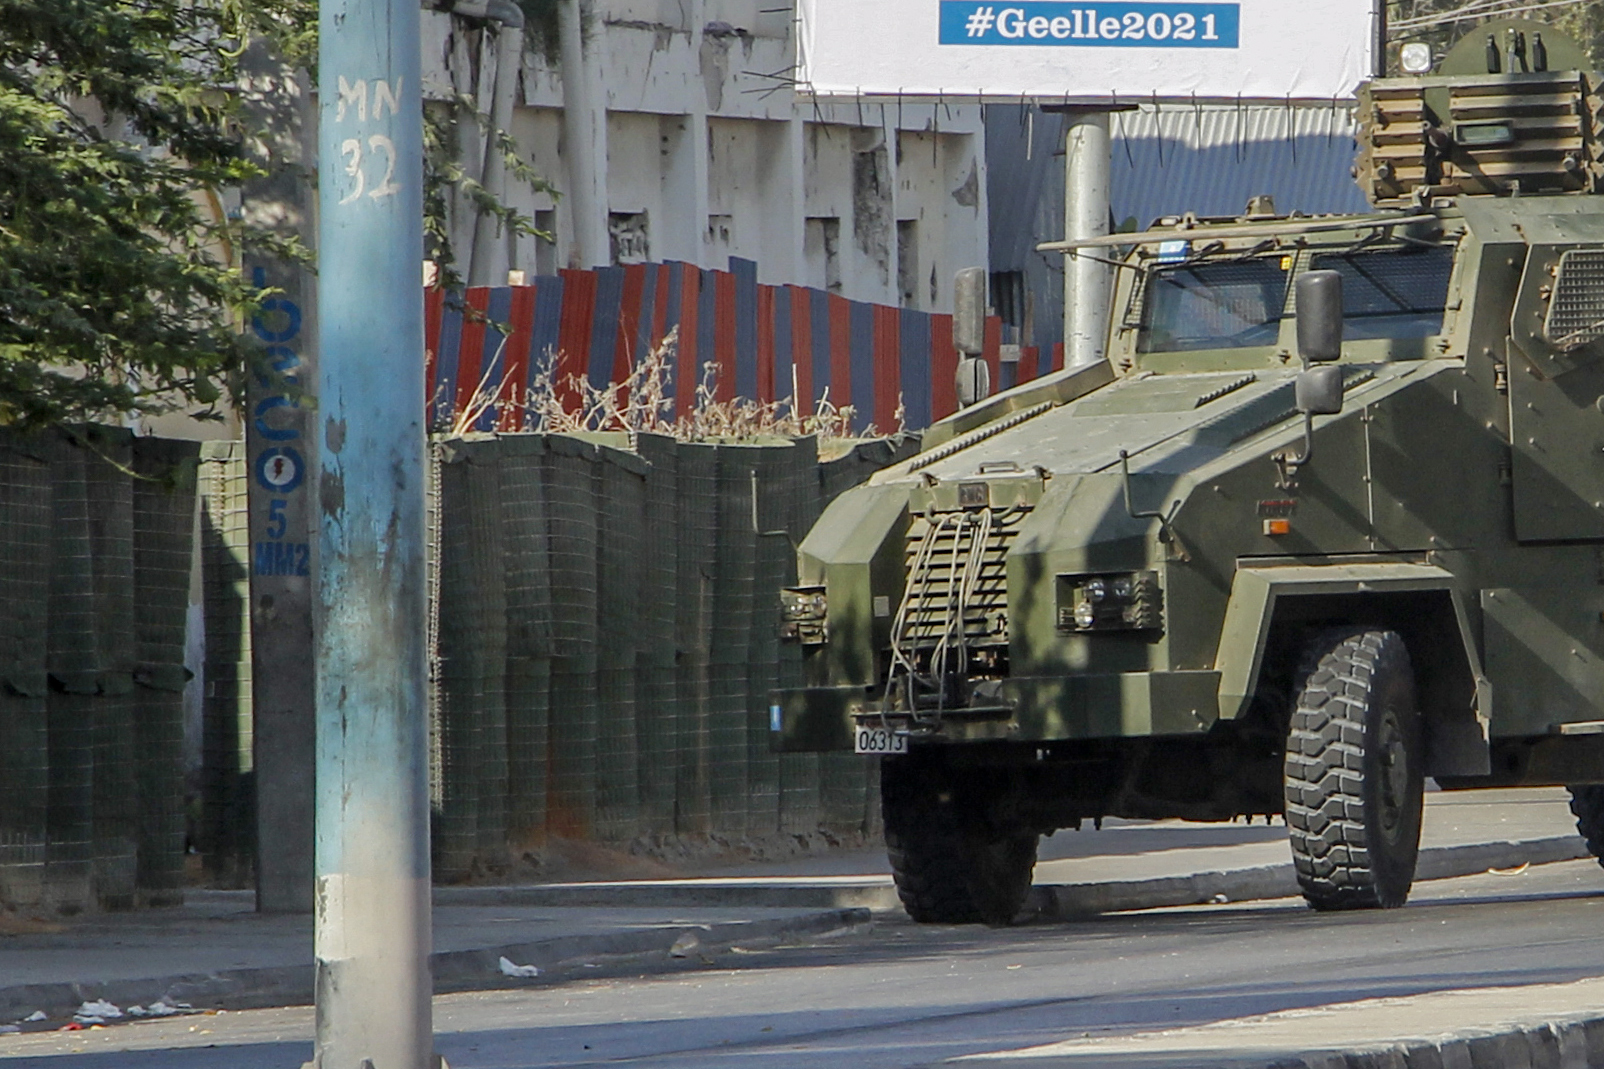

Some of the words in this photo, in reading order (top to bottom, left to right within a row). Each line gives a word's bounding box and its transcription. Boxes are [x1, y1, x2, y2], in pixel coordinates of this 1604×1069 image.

[964, 6, 1219, 40] #Geelle2021
[335, 75, 404, 122] MN
[338, 134, 401, 205] 32
[266, 499, 288, 540] 5
